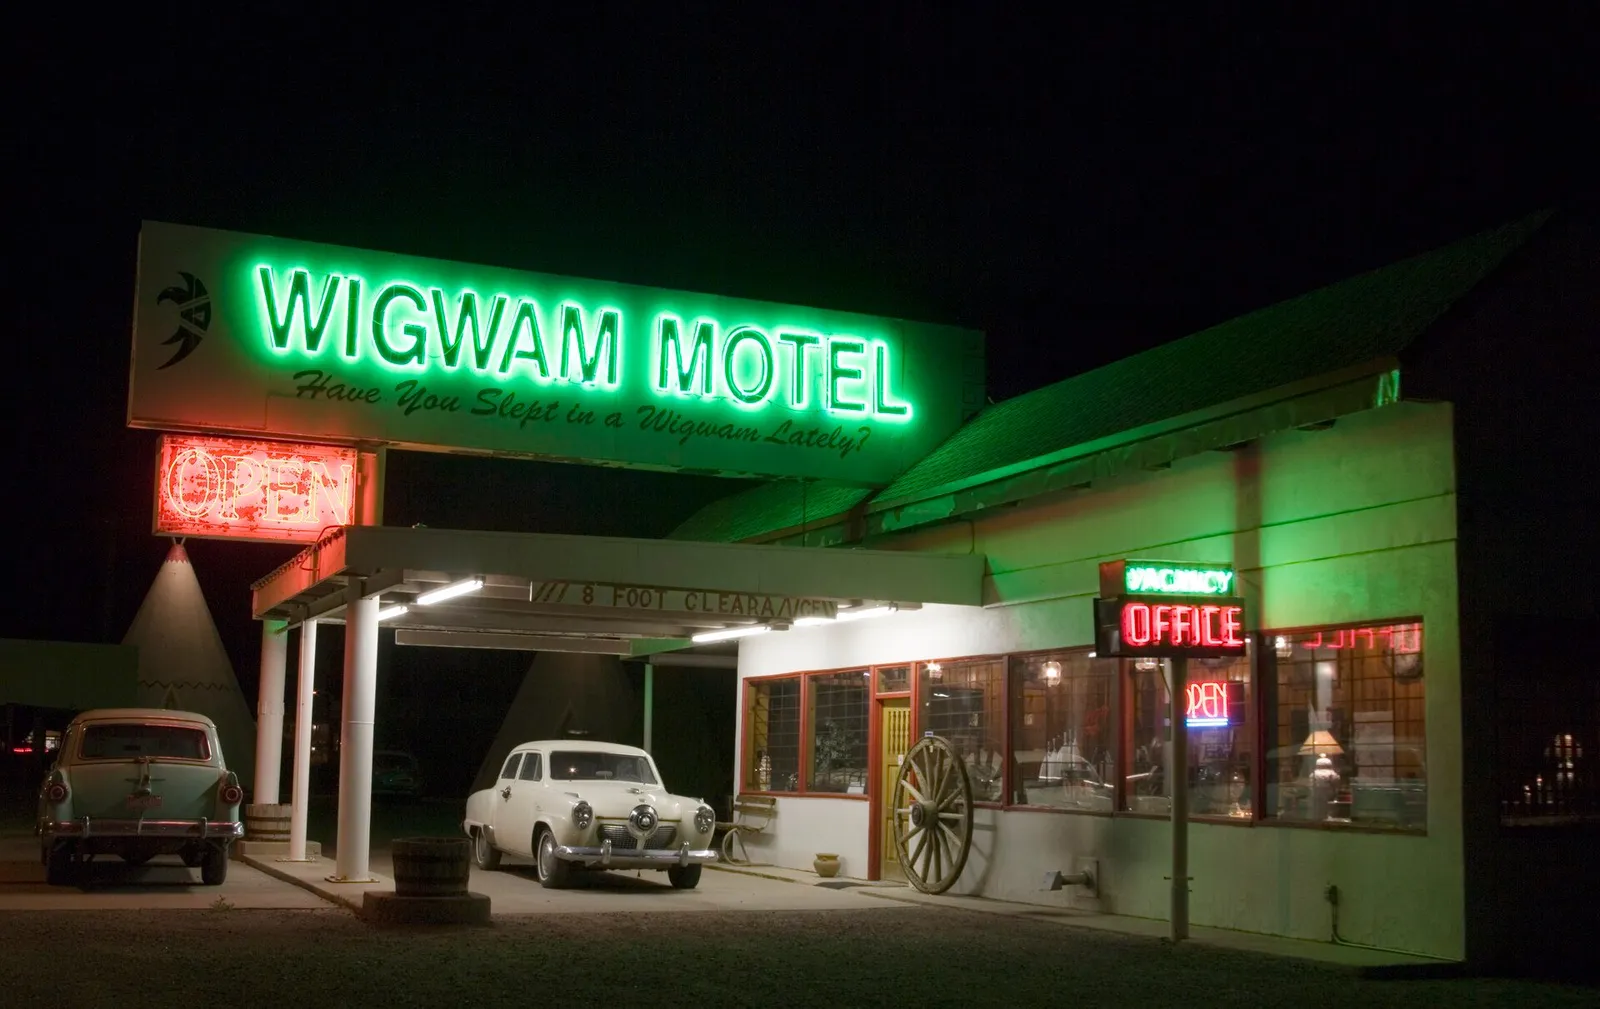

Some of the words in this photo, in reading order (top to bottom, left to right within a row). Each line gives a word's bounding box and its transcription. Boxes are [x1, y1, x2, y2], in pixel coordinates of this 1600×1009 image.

[254, 264, 621, 387] WIGWAM
[655, 314, 912, 419] MOTEL
[292, 369, 382, 404] Have
[395, 380, 460, 416] You
[470, 388, 558, 427] Slept
[565, 402, 596, 424] in
[604, 412, 623, 429] a
[636, 404, 760, 446] Wigwam
[763, 418, 872, 459] Lately?
[167, 448, 353, 525] OPEN
[581, 585, 596, 606] 8
[611, 586, 669, 611] FOOT
[1127, 567, 1233, 592] VACANCY
[1123, 603, 1243, 648] OFFICE
